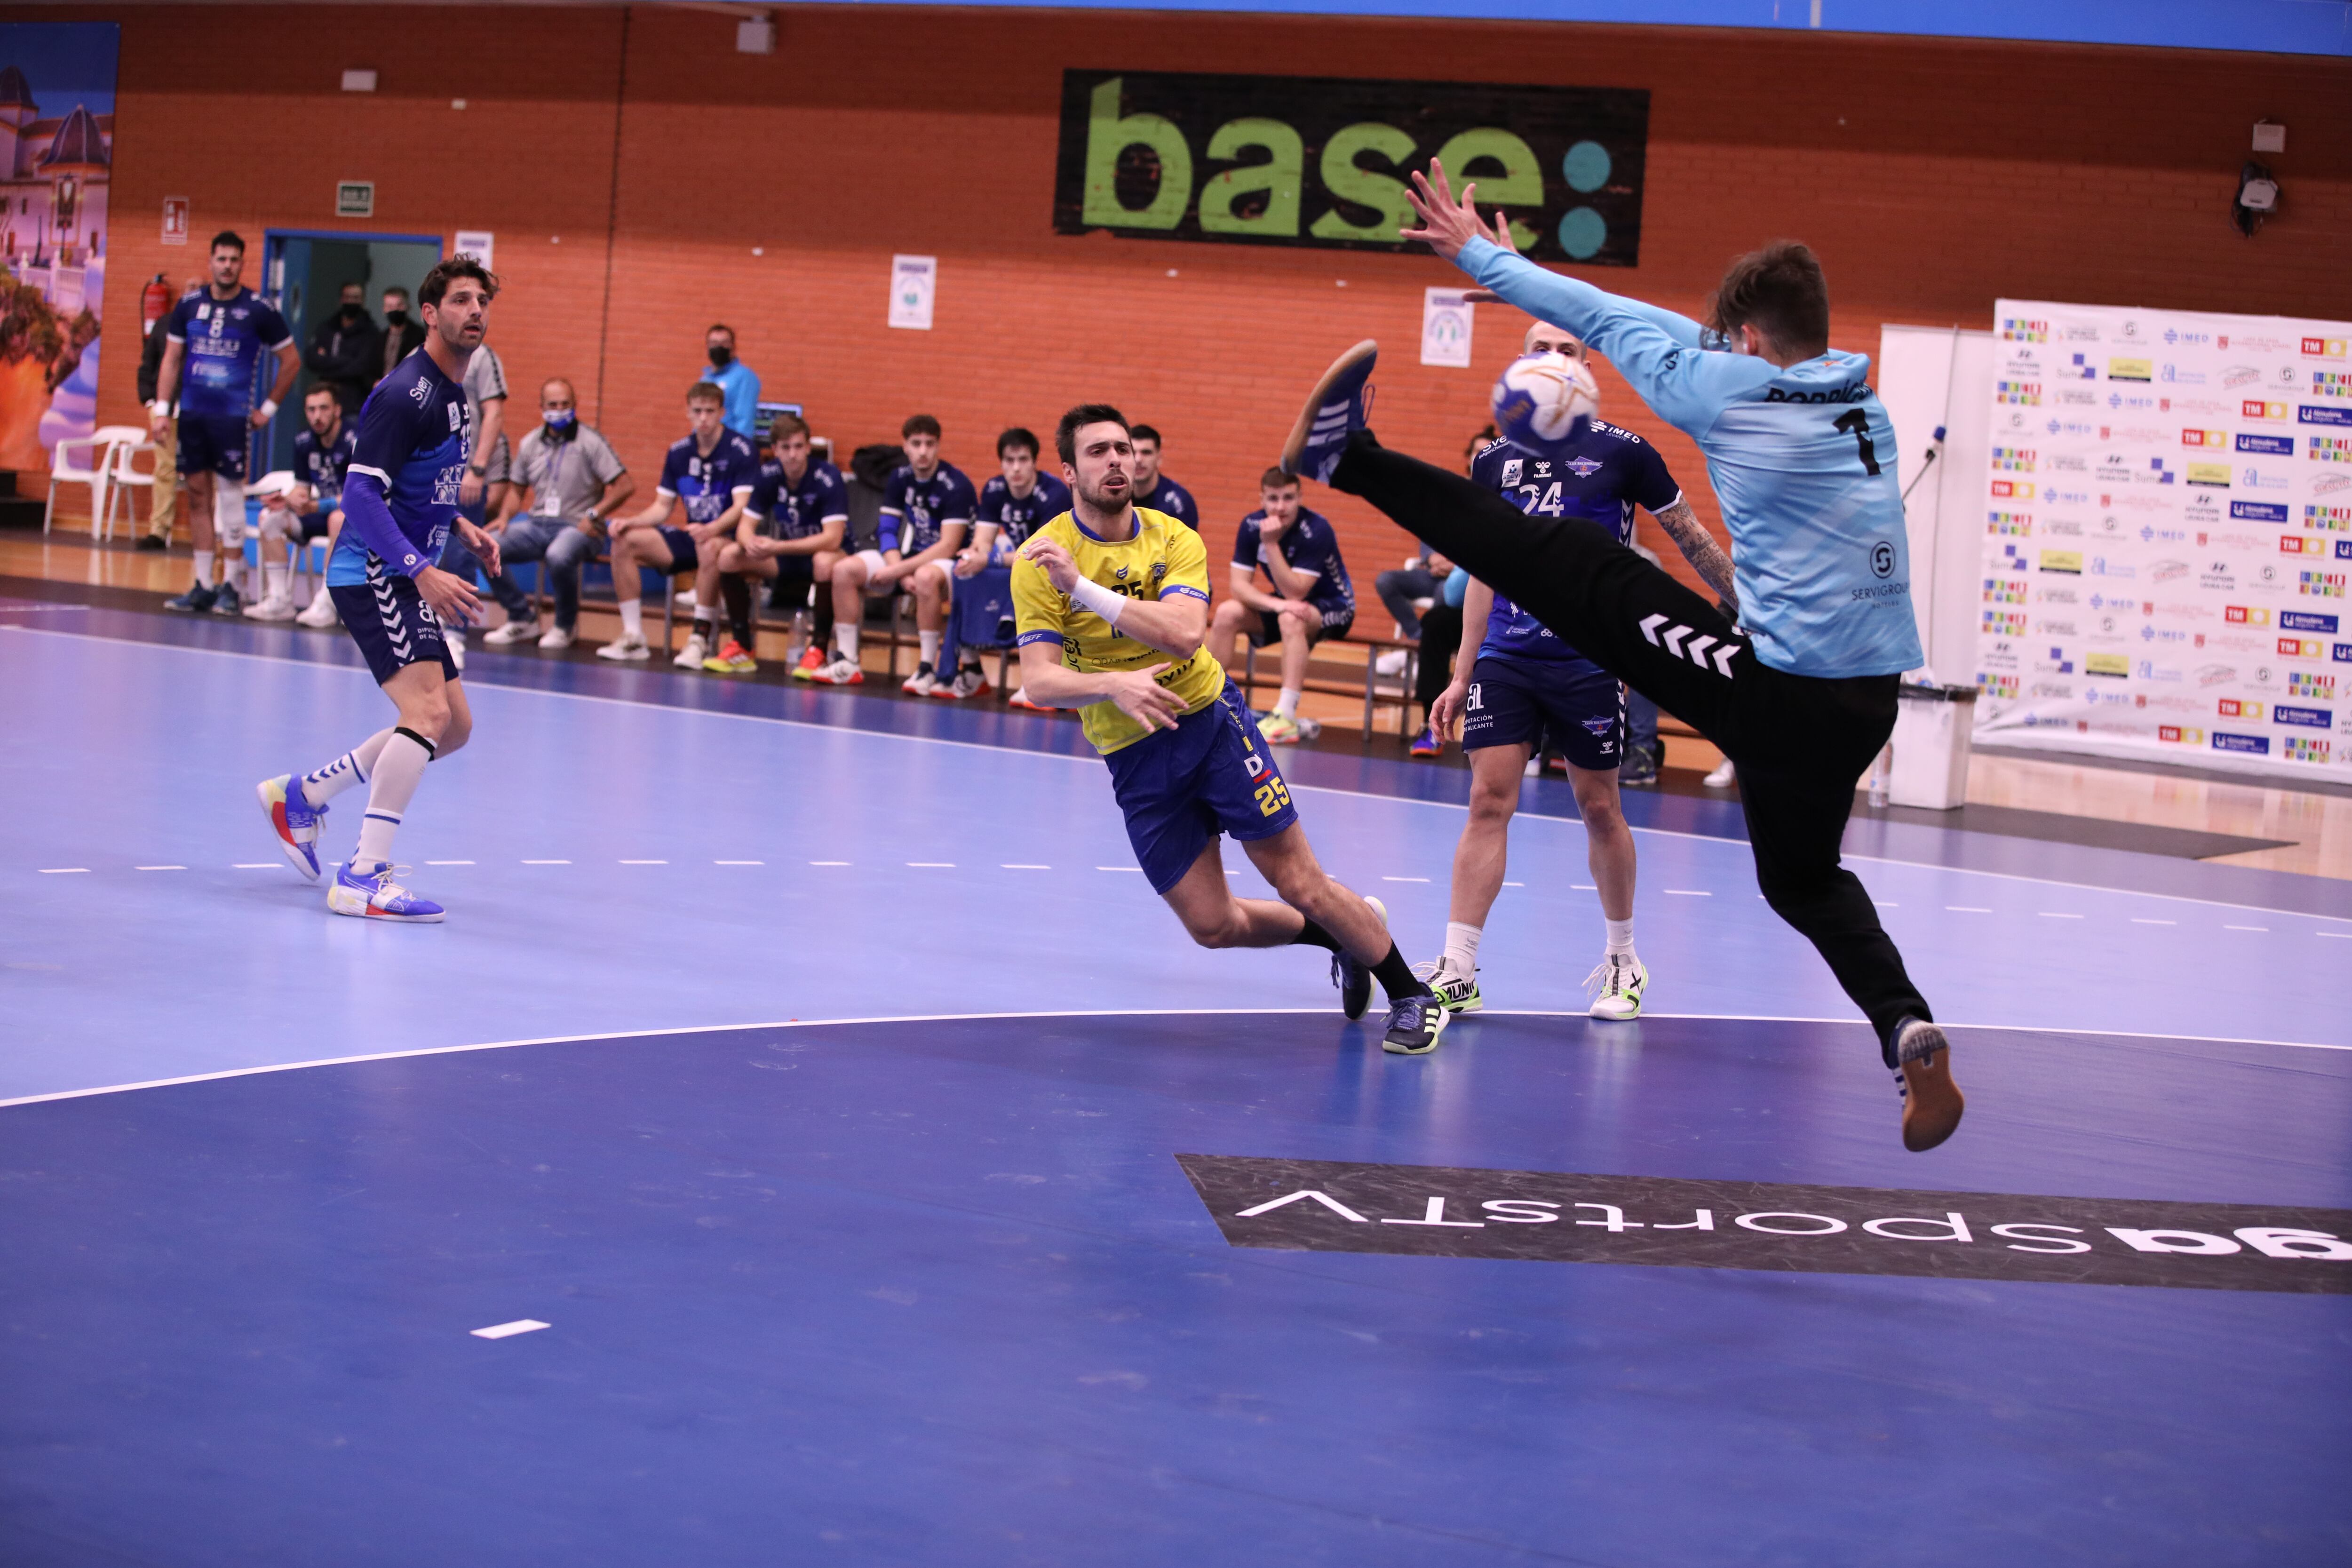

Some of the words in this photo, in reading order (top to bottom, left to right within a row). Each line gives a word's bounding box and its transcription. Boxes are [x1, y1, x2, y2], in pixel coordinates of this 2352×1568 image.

[2180, 334, 2209, 343] IMED
[2304, 341, 2320, 352] TM
[409, 376, 433, 401] Sven
[2125, 397, 2153, 407] IMED
[2244, 405, 2261, 415] TM
[1606, 432, 1627, 441] LEVANTE
[1608, 426, 1640, 444] IMED
[2184, 431, 2200, 443] TM
[1833, 408, 1881, 476] 1
[1519, 482, 1564, 517] 24
[2156, 530, 2185, 540] IMED
[2283, 540, 2299, 550] TM
[2227, 609, 2245, 620] TM
[1025, 634, 1043, 642] GEFF
[2280, 642, 2296, 653] TM
[2220, 702, 2238, 714] TM
[1468, 722, 1494, 731] ALICANTE
[2161, 729, 2178, 740] TM
[1254, 776, 1290, 818] 25
